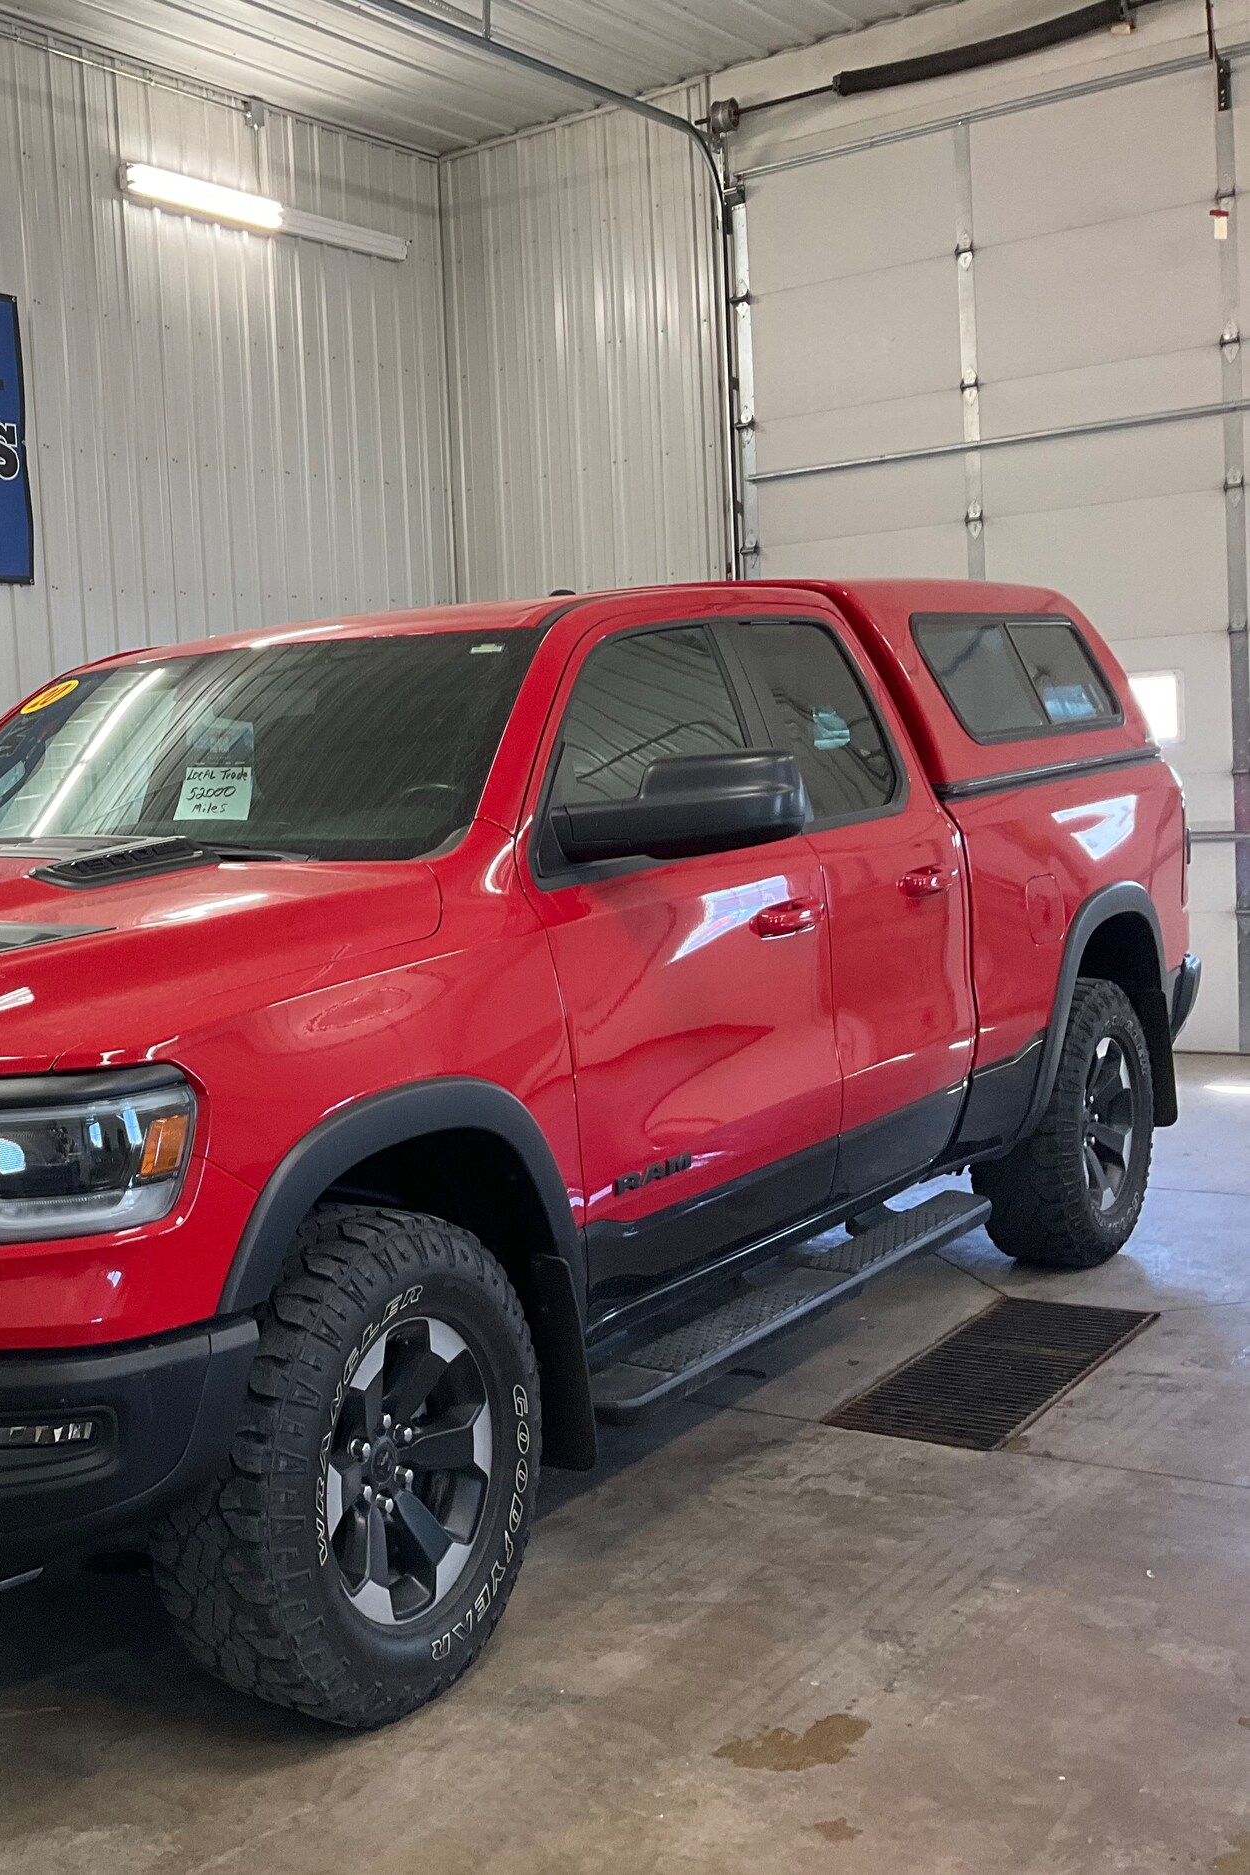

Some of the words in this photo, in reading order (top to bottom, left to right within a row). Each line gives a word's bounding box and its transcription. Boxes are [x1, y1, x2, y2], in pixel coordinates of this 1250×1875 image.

[186, 786, 237, 801] 52000
[614, 1152, 692, 1197] RAM
[316, 1285, 423, 1567] WRANGLER
[432, 1384, 530, 1661] GOODYEAR
